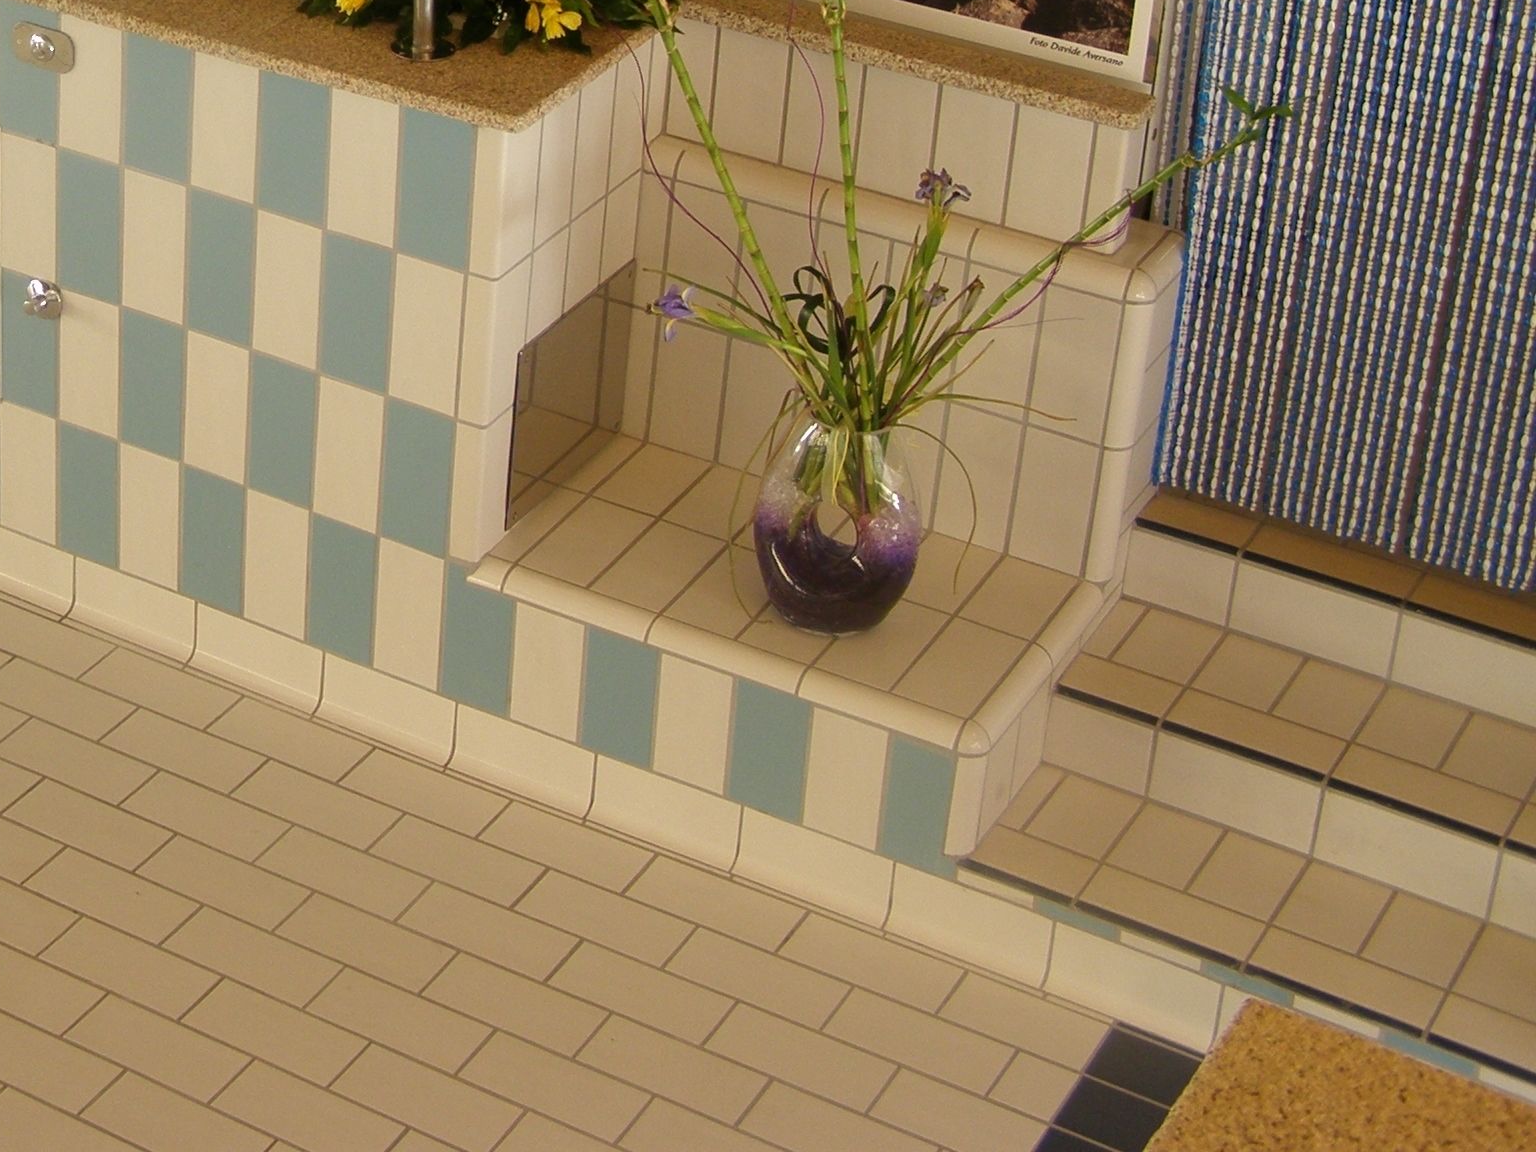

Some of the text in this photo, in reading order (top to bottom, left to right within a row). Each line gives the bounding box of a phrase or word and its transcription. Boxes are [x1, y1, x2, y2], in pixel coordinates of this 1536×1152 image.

[1029, 36, 1124, 66] Foto Davide Aversano
